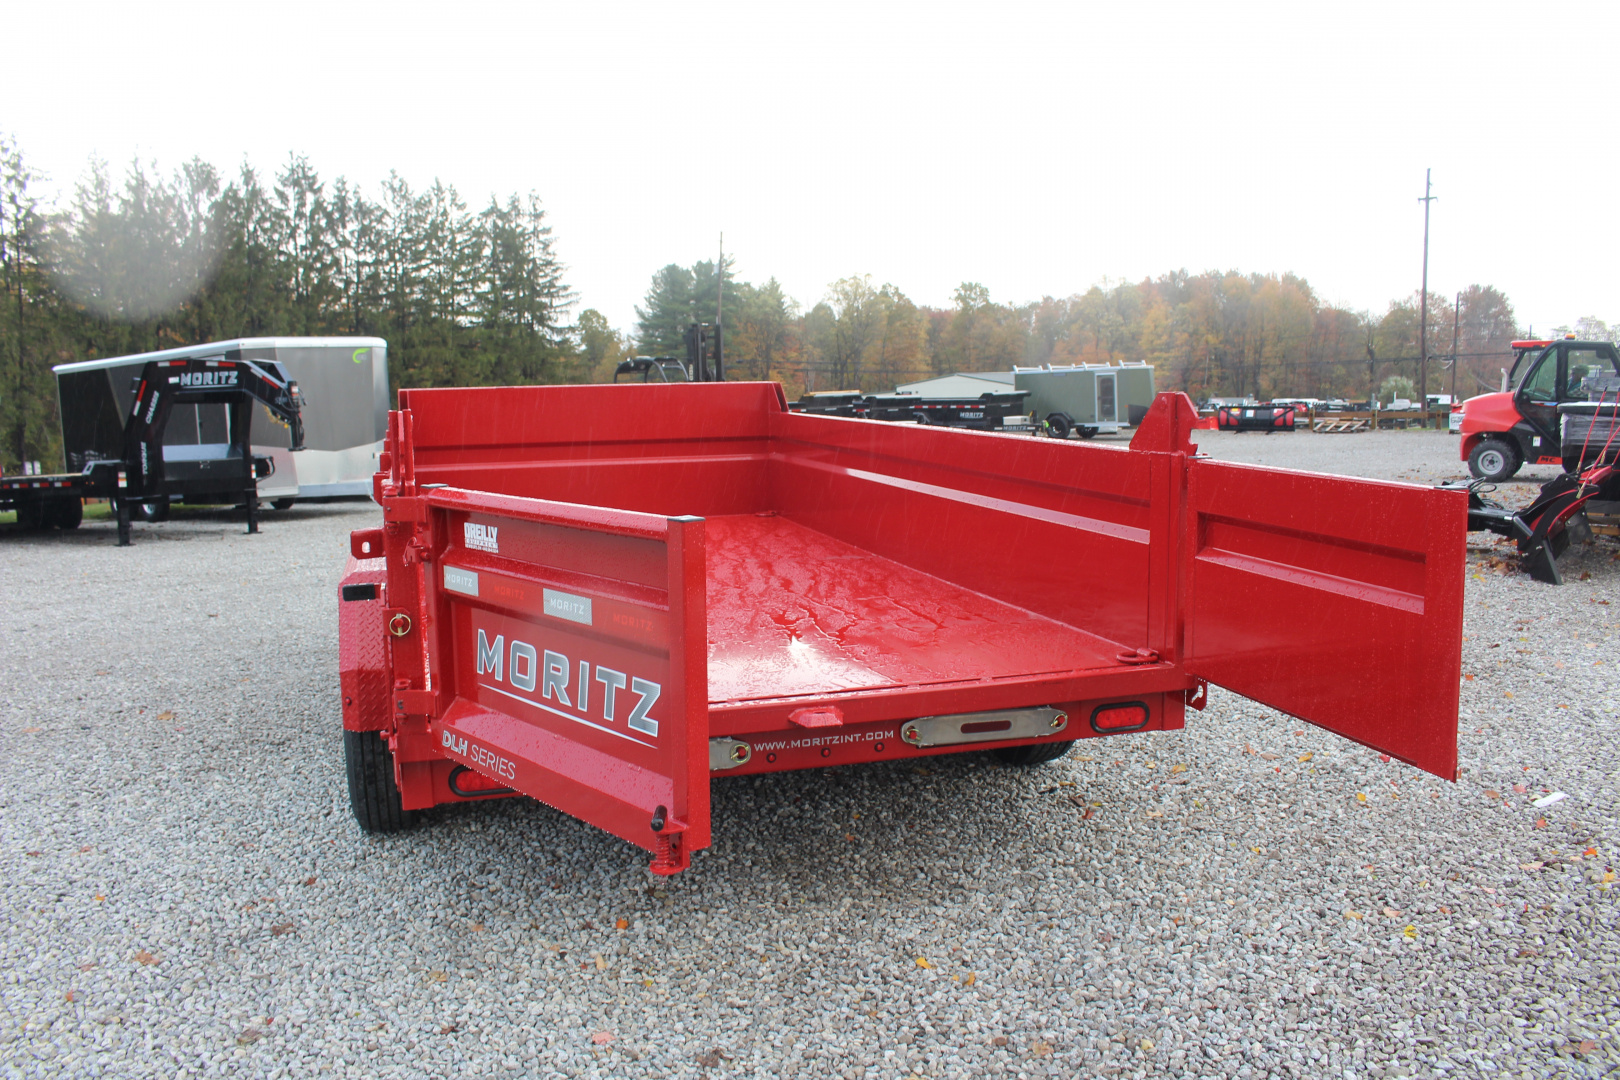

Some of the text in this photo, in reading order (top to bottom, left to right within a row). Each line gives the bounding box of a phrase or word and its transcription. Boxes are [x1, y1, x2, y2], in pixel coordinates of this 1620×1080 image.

[180, 371, 238, 386] MORITZ
[445, 573, 653, 632] MORITZ MORITZ MORITZ MORITZ
[476, 628, 661, 738] MORITZ
[441, 729, 516, 781] DLH SERIES
[754, 730, 894, 752] WWW.MORITZINT.COM
